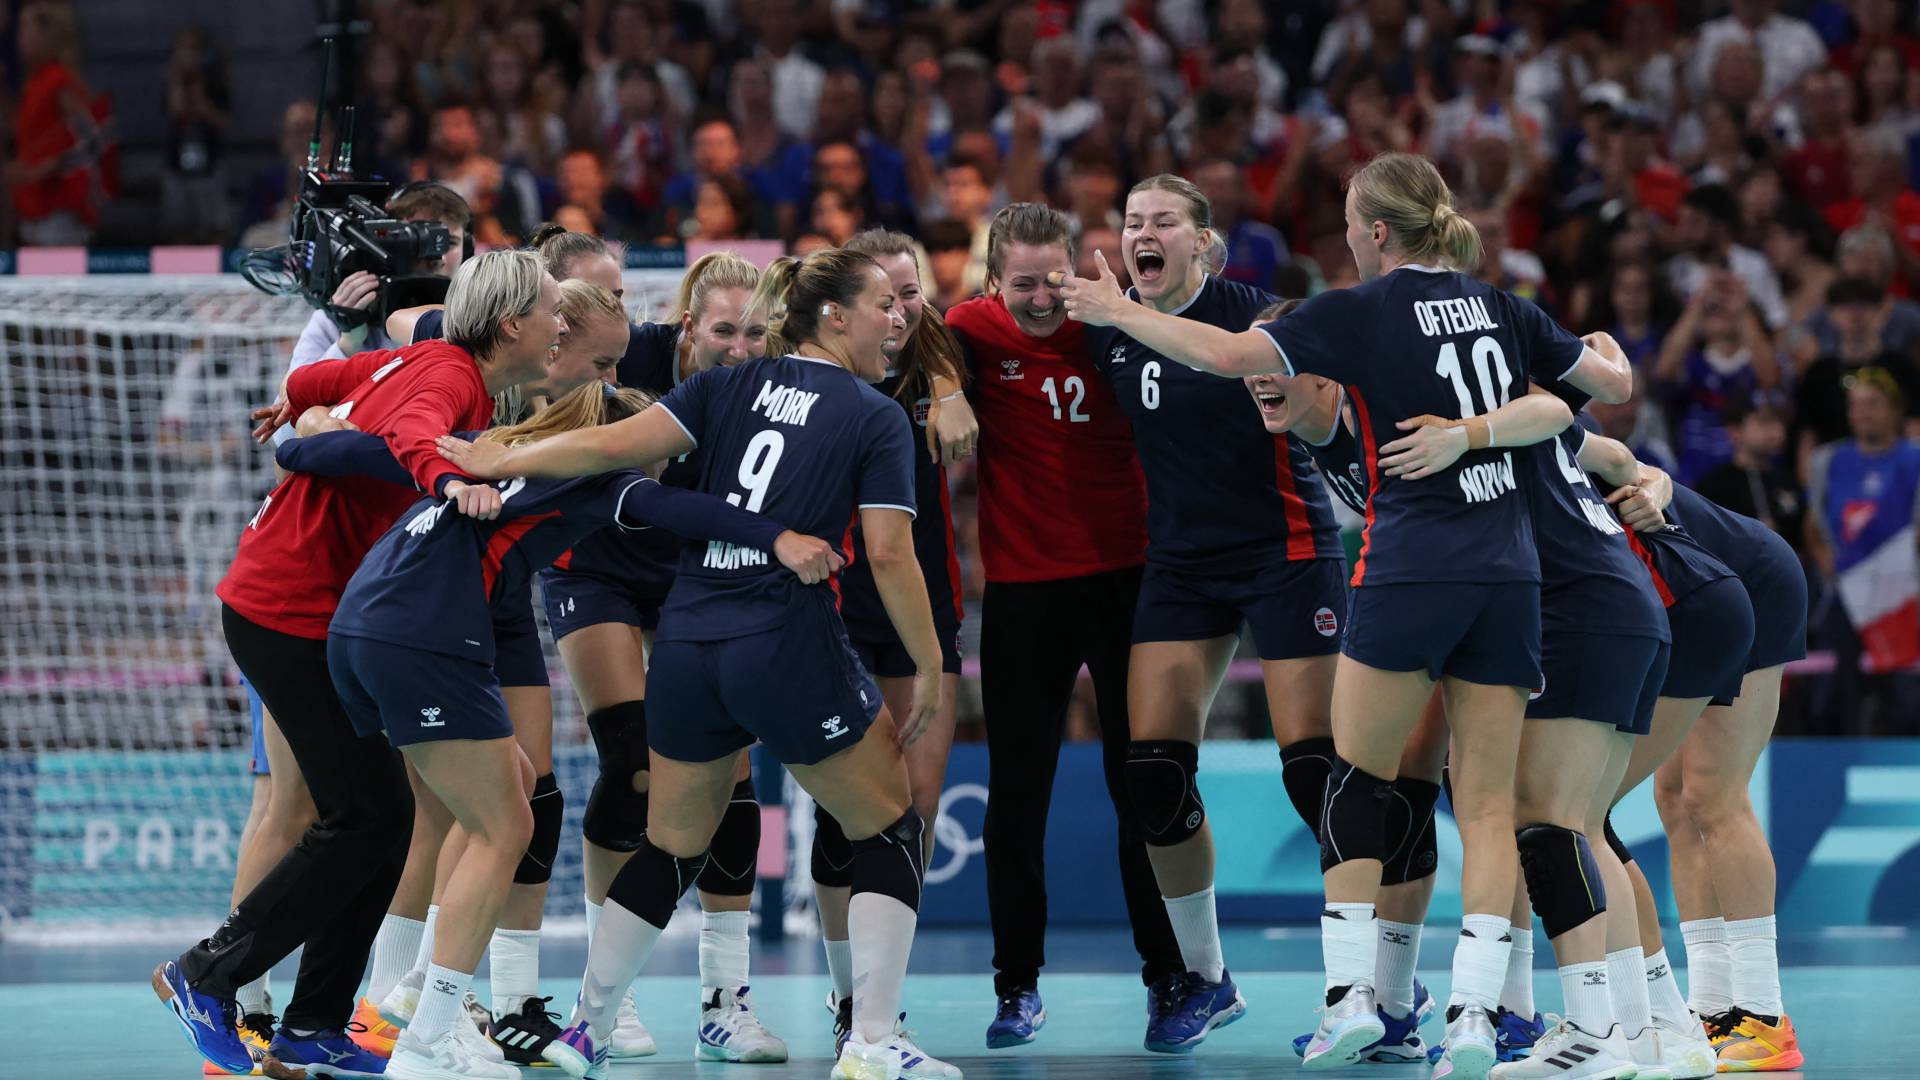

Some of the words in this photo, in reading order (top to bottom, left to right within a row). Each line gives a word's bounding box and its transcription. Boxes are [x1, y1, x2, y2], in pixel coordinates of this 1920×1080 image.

[1413, 296, 1499, 337] OFTEDAL
[1000, 372, 1025, 381] hummel
[1040, 375, 1090, 422] 12
[1141, 361, 1162, 410] 6
[1435, 335, 1513, 419] 10
[751, 379, 820, 427] MØRK
[725, 429, 785, 514] 9
[559, 596, 576, 617] 14
[860, 689, 868, 705] 9
